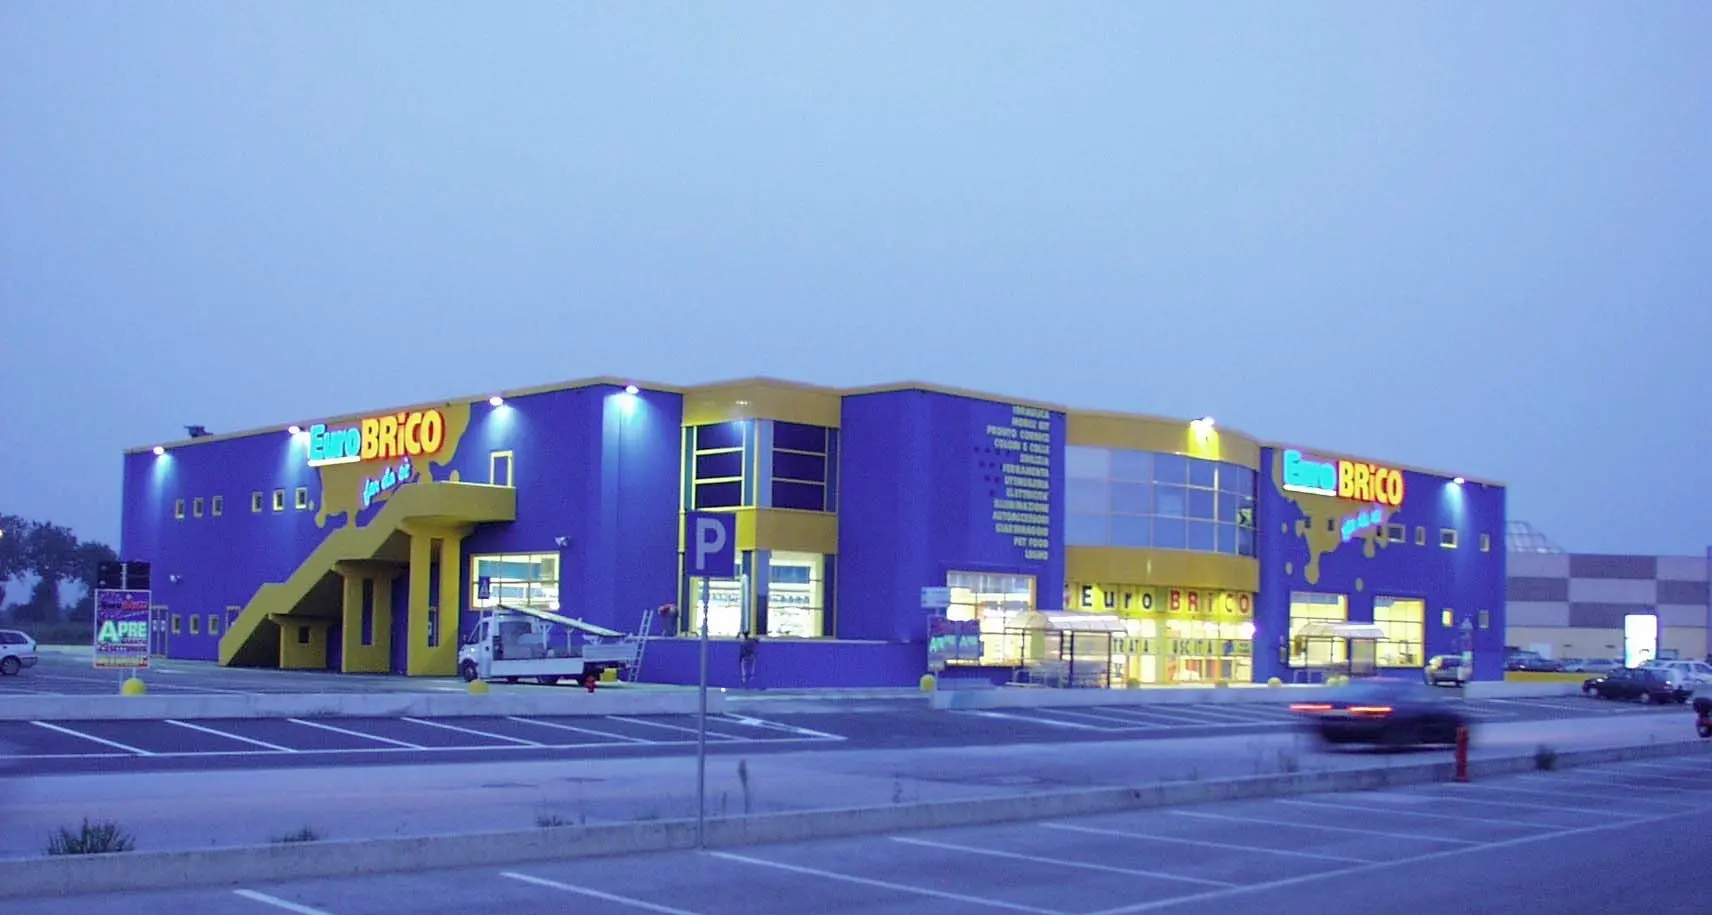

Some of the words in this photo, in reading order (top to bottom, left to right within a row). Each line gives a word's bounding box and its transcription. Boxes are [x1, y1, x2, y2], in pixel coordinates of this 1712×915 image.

[310, 424, 360, 460] Euro
[696, 517, 726, 570] P
[1082, 585, 1152, 609] Euro
[98, 620, 148, 643] APRE
